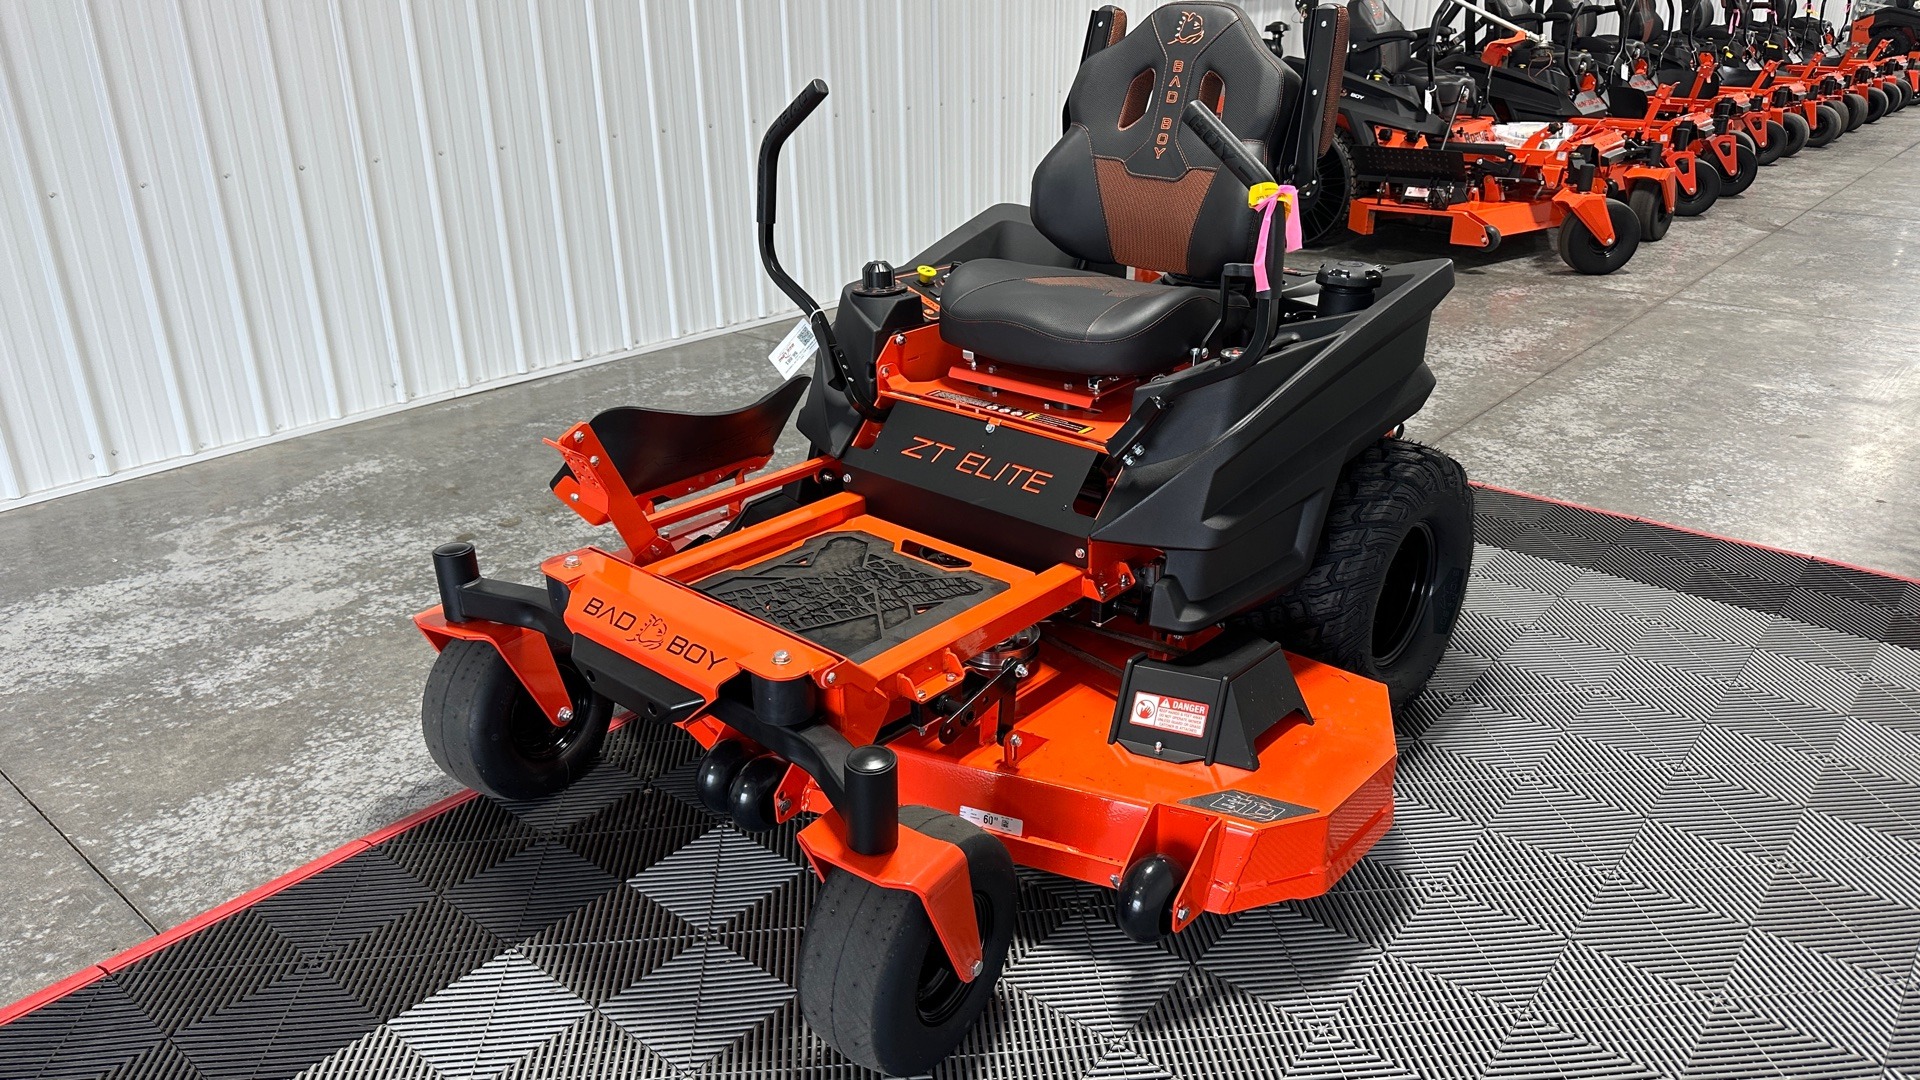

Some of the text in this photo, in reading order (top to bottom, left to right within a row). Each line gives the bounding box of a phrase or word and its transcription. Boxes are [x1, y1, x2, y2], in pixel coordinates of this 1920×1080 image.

[1153, 117, 1173, 159] BOY
[900, 435, 1054, 494] ZT ELITE
[582, 597, 728, 671] BAD BOY
[1172, 700, 1206, 715] DANGER
